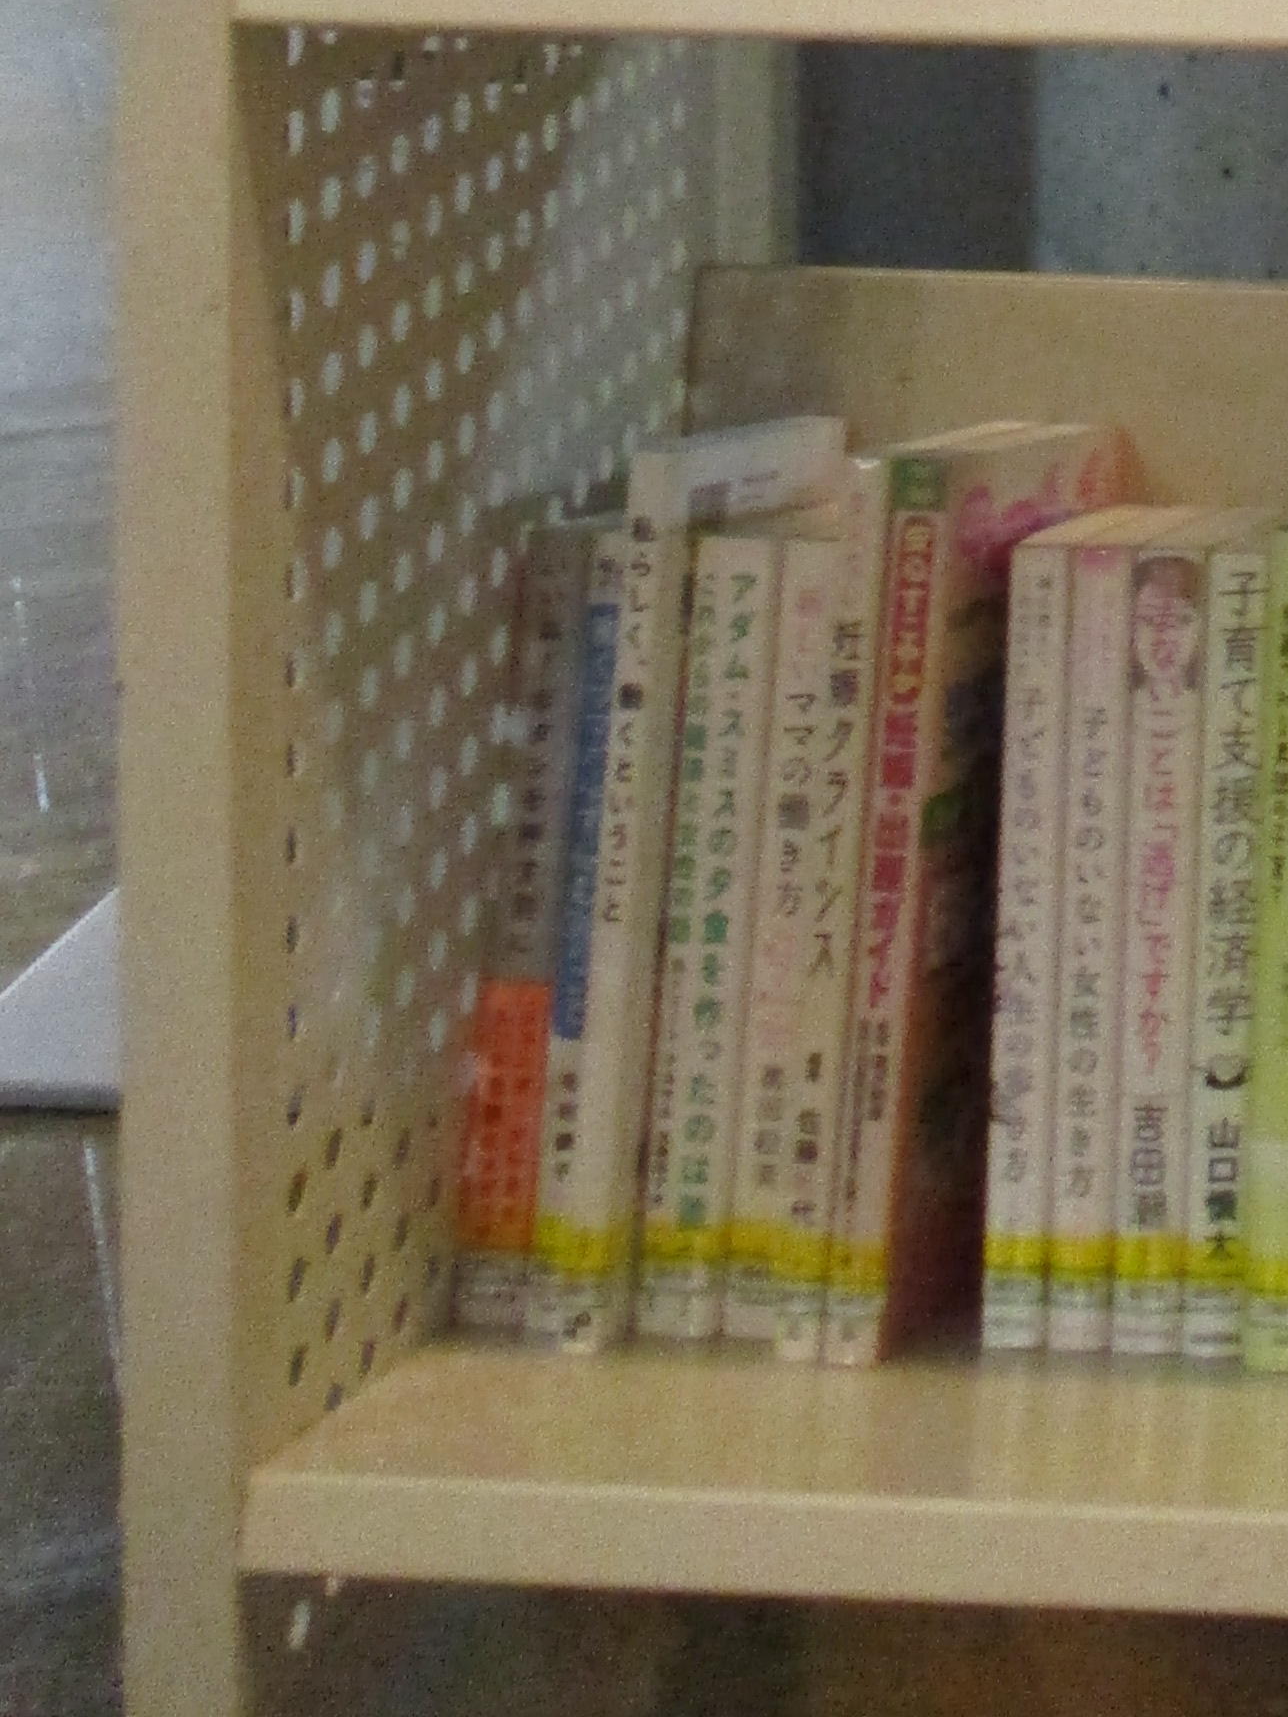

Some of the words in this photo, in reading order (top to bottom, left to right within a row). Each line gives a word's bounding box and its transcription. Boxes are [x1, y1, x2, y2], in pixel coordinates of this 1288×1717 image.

[1202, 569, 1261, 1040] 子育て支援の経済学
